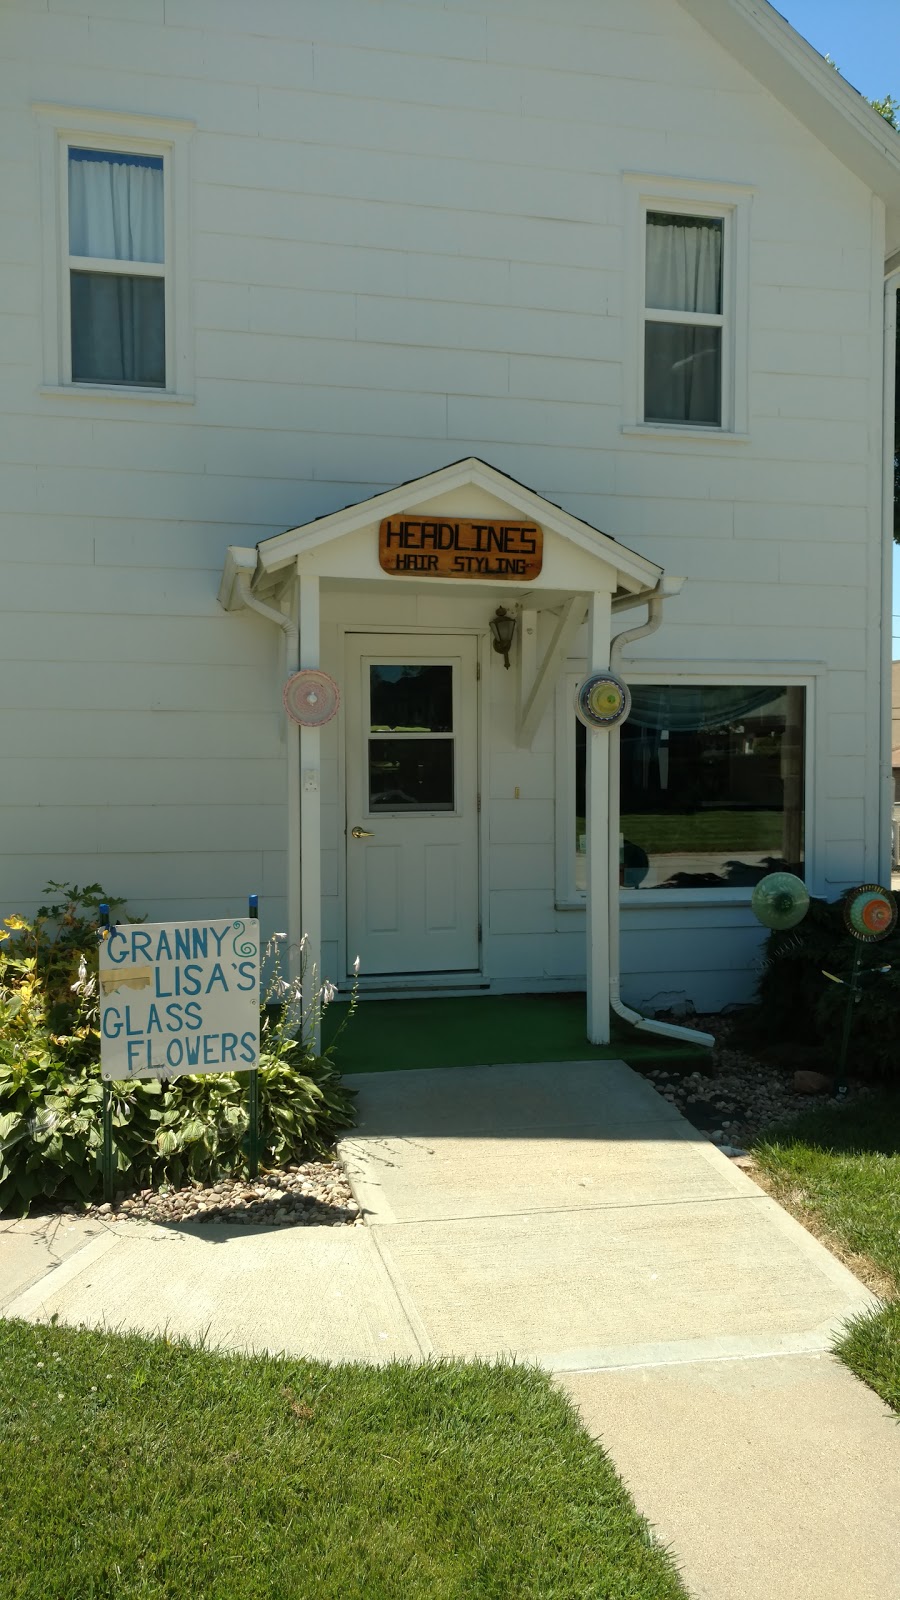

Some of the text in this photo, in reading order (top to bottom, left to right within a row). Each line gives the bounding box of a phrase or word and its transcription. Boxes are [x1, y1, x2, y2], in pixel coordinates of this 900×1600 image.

[386, 521, 536, 554] HEADLINES
[396, 554, 526, 574] HAIR STYLING
[107, 926, 231, 963] GRANNY
[155, 962, 256, 998] LISA'S
[103, 1002, 203, 1039] GLASS
[127, 1032, 257, 1070] FLOWERS
